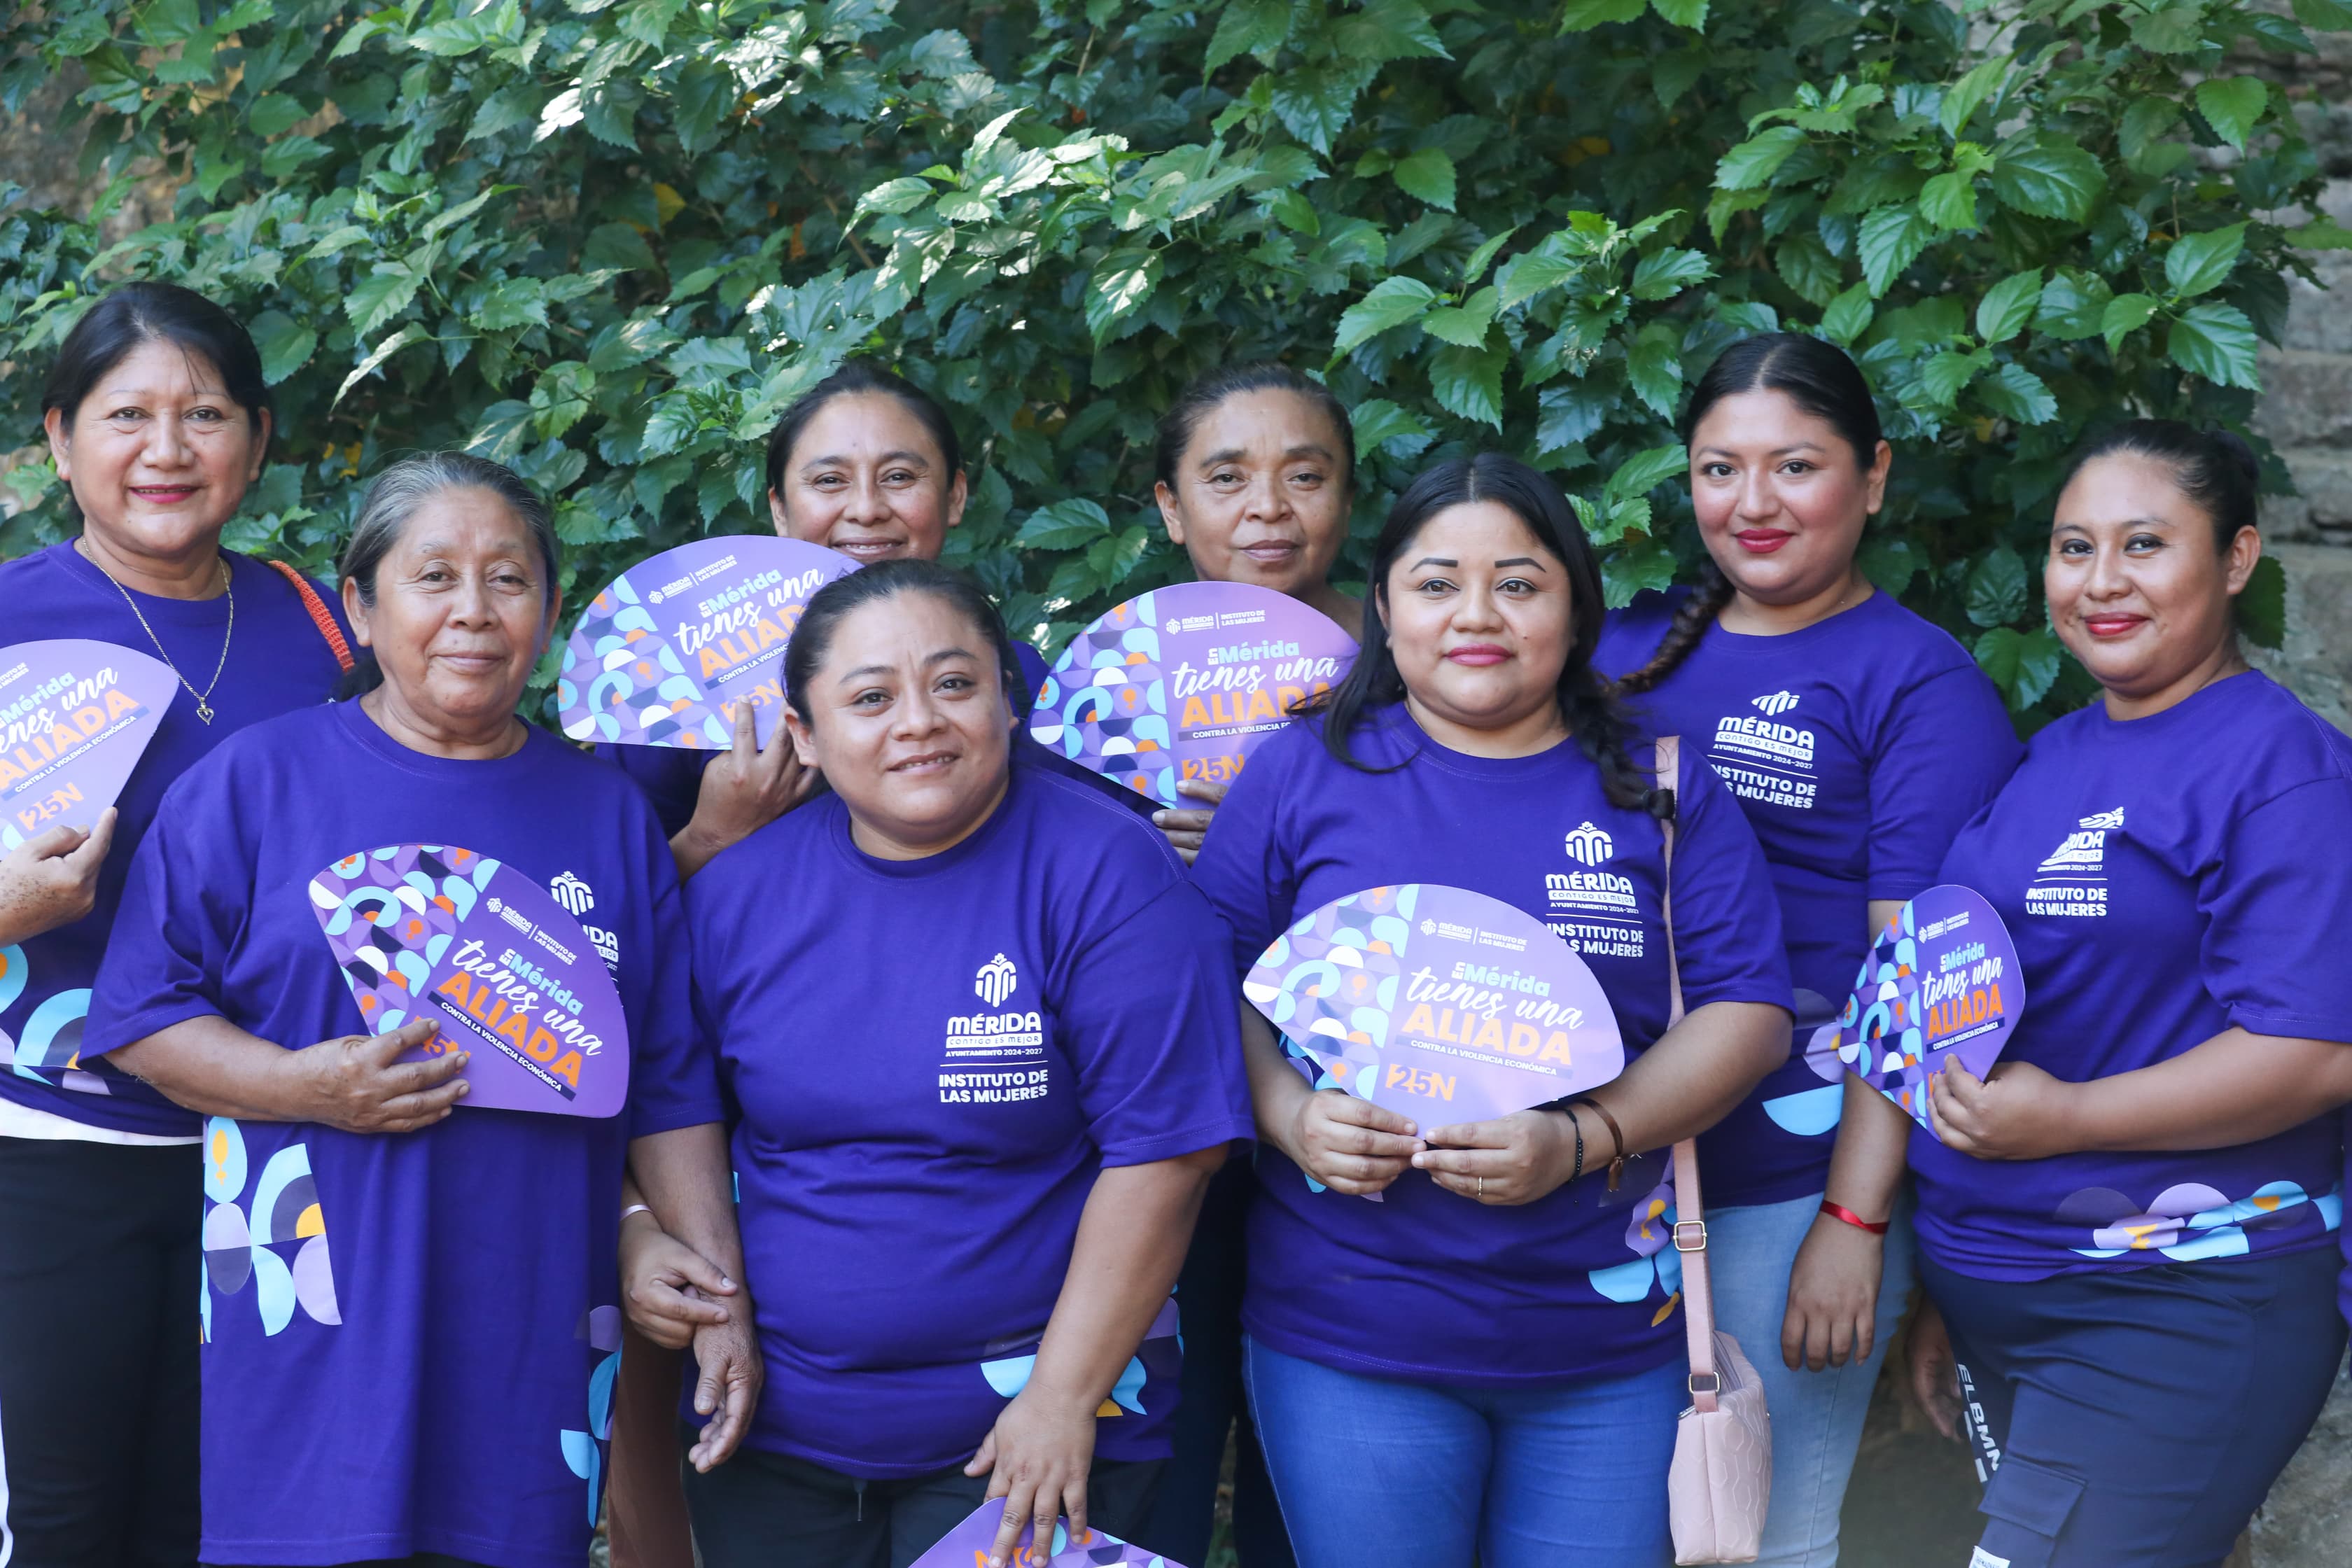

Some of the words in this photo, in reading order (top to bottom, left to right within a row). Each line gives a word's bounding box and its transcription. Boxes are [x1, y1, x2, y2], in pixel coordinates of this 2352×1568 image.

[709, 568, 783, 614] Mérida
[673, 604, 762, 655] tienes
[767, 568, 824, 608] una
[718, 666, 749, 683] CONTRA
[748, 659, 760, 668] LA
[757, 643, 790, 663] VIOLENC
[1219, 640, 1299, 664] Mérida
[61, 667, 118, 710] una
[1172, 662, 1266, 699] tienes
[1274, 657, 1338, 683] una
[0, 672, 76, 724] Mérida
[1192, 729, 1226, 738] CONTRA
[1238, 722, 1280, 734] VIOLENCIA
[1718, 716, 1814, 749] MÉRIDA
[1718, 733, 1761, 746] CONTIGO
[1779, 746, 1809, 758] MEJOR
[15, 772, 46, 792] CONTRA
[45, 764, 56, 774] LA
[55, 742, 93, 768] VIOLENCIA
[91, 715, 136, 746] ECONÓMICA
[1713, 743, 1772, 760] AYUNTAMIENTO
[1772, 755, 1813, 769] 2024-2027
[1736, 784, 1813, 808] MUJERES
[1795, 782, 1816, 797] DE
[17, 782, 85, 831] 25N
[1546, 871, 1634, 895] MÉRIDA
[2026, 888, 2085, 901] INSTITUTO
[2087, 888, 2108, 901] DE
[1550, 902, 1608, 911] AYUNTAMIENTO
[1610, 895, 1634, 904] MEJOR
[2026, 902, 2045, 915] LAS
[2045, 903, 2107, 916] MUJERES
[1480, 930, 1517, 944] INSTITUTO
[1583, 940, 1644, 958] MUJERES
[1630, 930, 1644, 943] DE
[568, 951, 577, 960] DE
[1946, 941, 1985, 971] Mérida
[508, 953, 584, 1016] Mérida
[1464, 964, 1550, 997] Mérida
[1922, 969, 1969, 1009] tienes
[1972, 956, 2003, 986] una
[452, 939, 539, 1014] tienes
[544, 1007, 603, 1056] una
[1406, 966, 1507, 1020] tienes
[1516, 997, 1585, 1029] una
[1927, 983, 2003, 1040] ALIADA
[438, 970, 583, 1088] ALIADA
[946, 1011, 1042, 1035] MÉRIDA
[1402, 1004, 1572, 1065] ALIADA
[441, 1002, 471, 1027] CONTRA
[470, 1023, 481, 1034] LA
[481, 1029, 518, 1060] VIOLENCIA
[517, 1056, 561, 1091] ECONÓMICA
[1008, 1035, 1040, 1044] MEJOR
[1410, 1040, 1446, 1054] CONTRA
[1448, 1046, 1457, 1056] LA
[1459, 1049, 1503, 1065] VIOLENCIA
[1504, 1058, 1558, 1076] ECONÓMICA
[939, 1072, 1026, 1087] INSTITUTO
[1028, 1070, 1048, 1084] DE
[940, 1090, 970, 1102] LAS
[974, 1084, 1048, 1102] MUJERES
[1385, 1063, 1457, 1101] 25N
